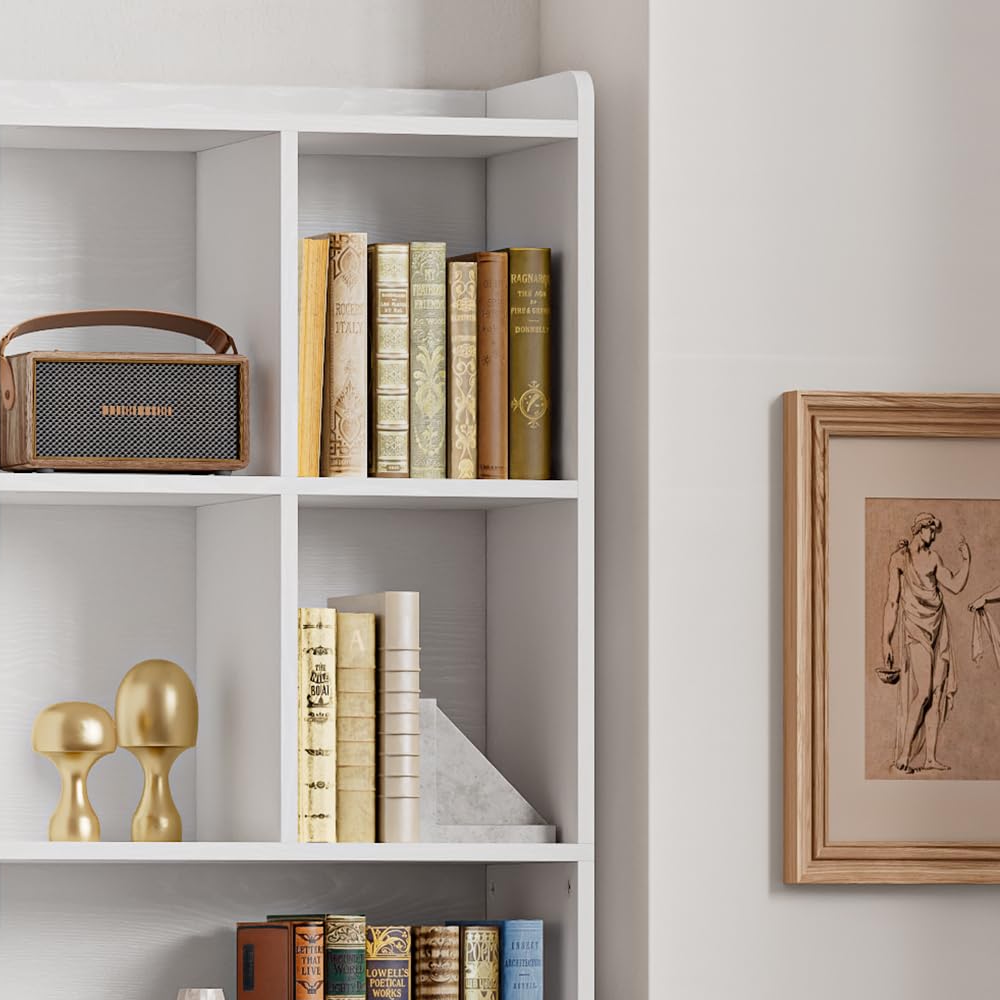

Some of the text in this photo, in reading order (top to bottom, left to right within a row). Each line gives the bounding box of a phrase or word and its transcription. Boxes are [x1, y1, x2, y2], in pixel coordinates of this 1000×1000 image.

[302, 957, 321, 966] THAT
[301, 967, 321, 976] LIVE
[366, 967, 409, 978] LOWELL'S
[369, 978, 406, 988] POETICAL
[372, 988, 402, 1000] WORKS
